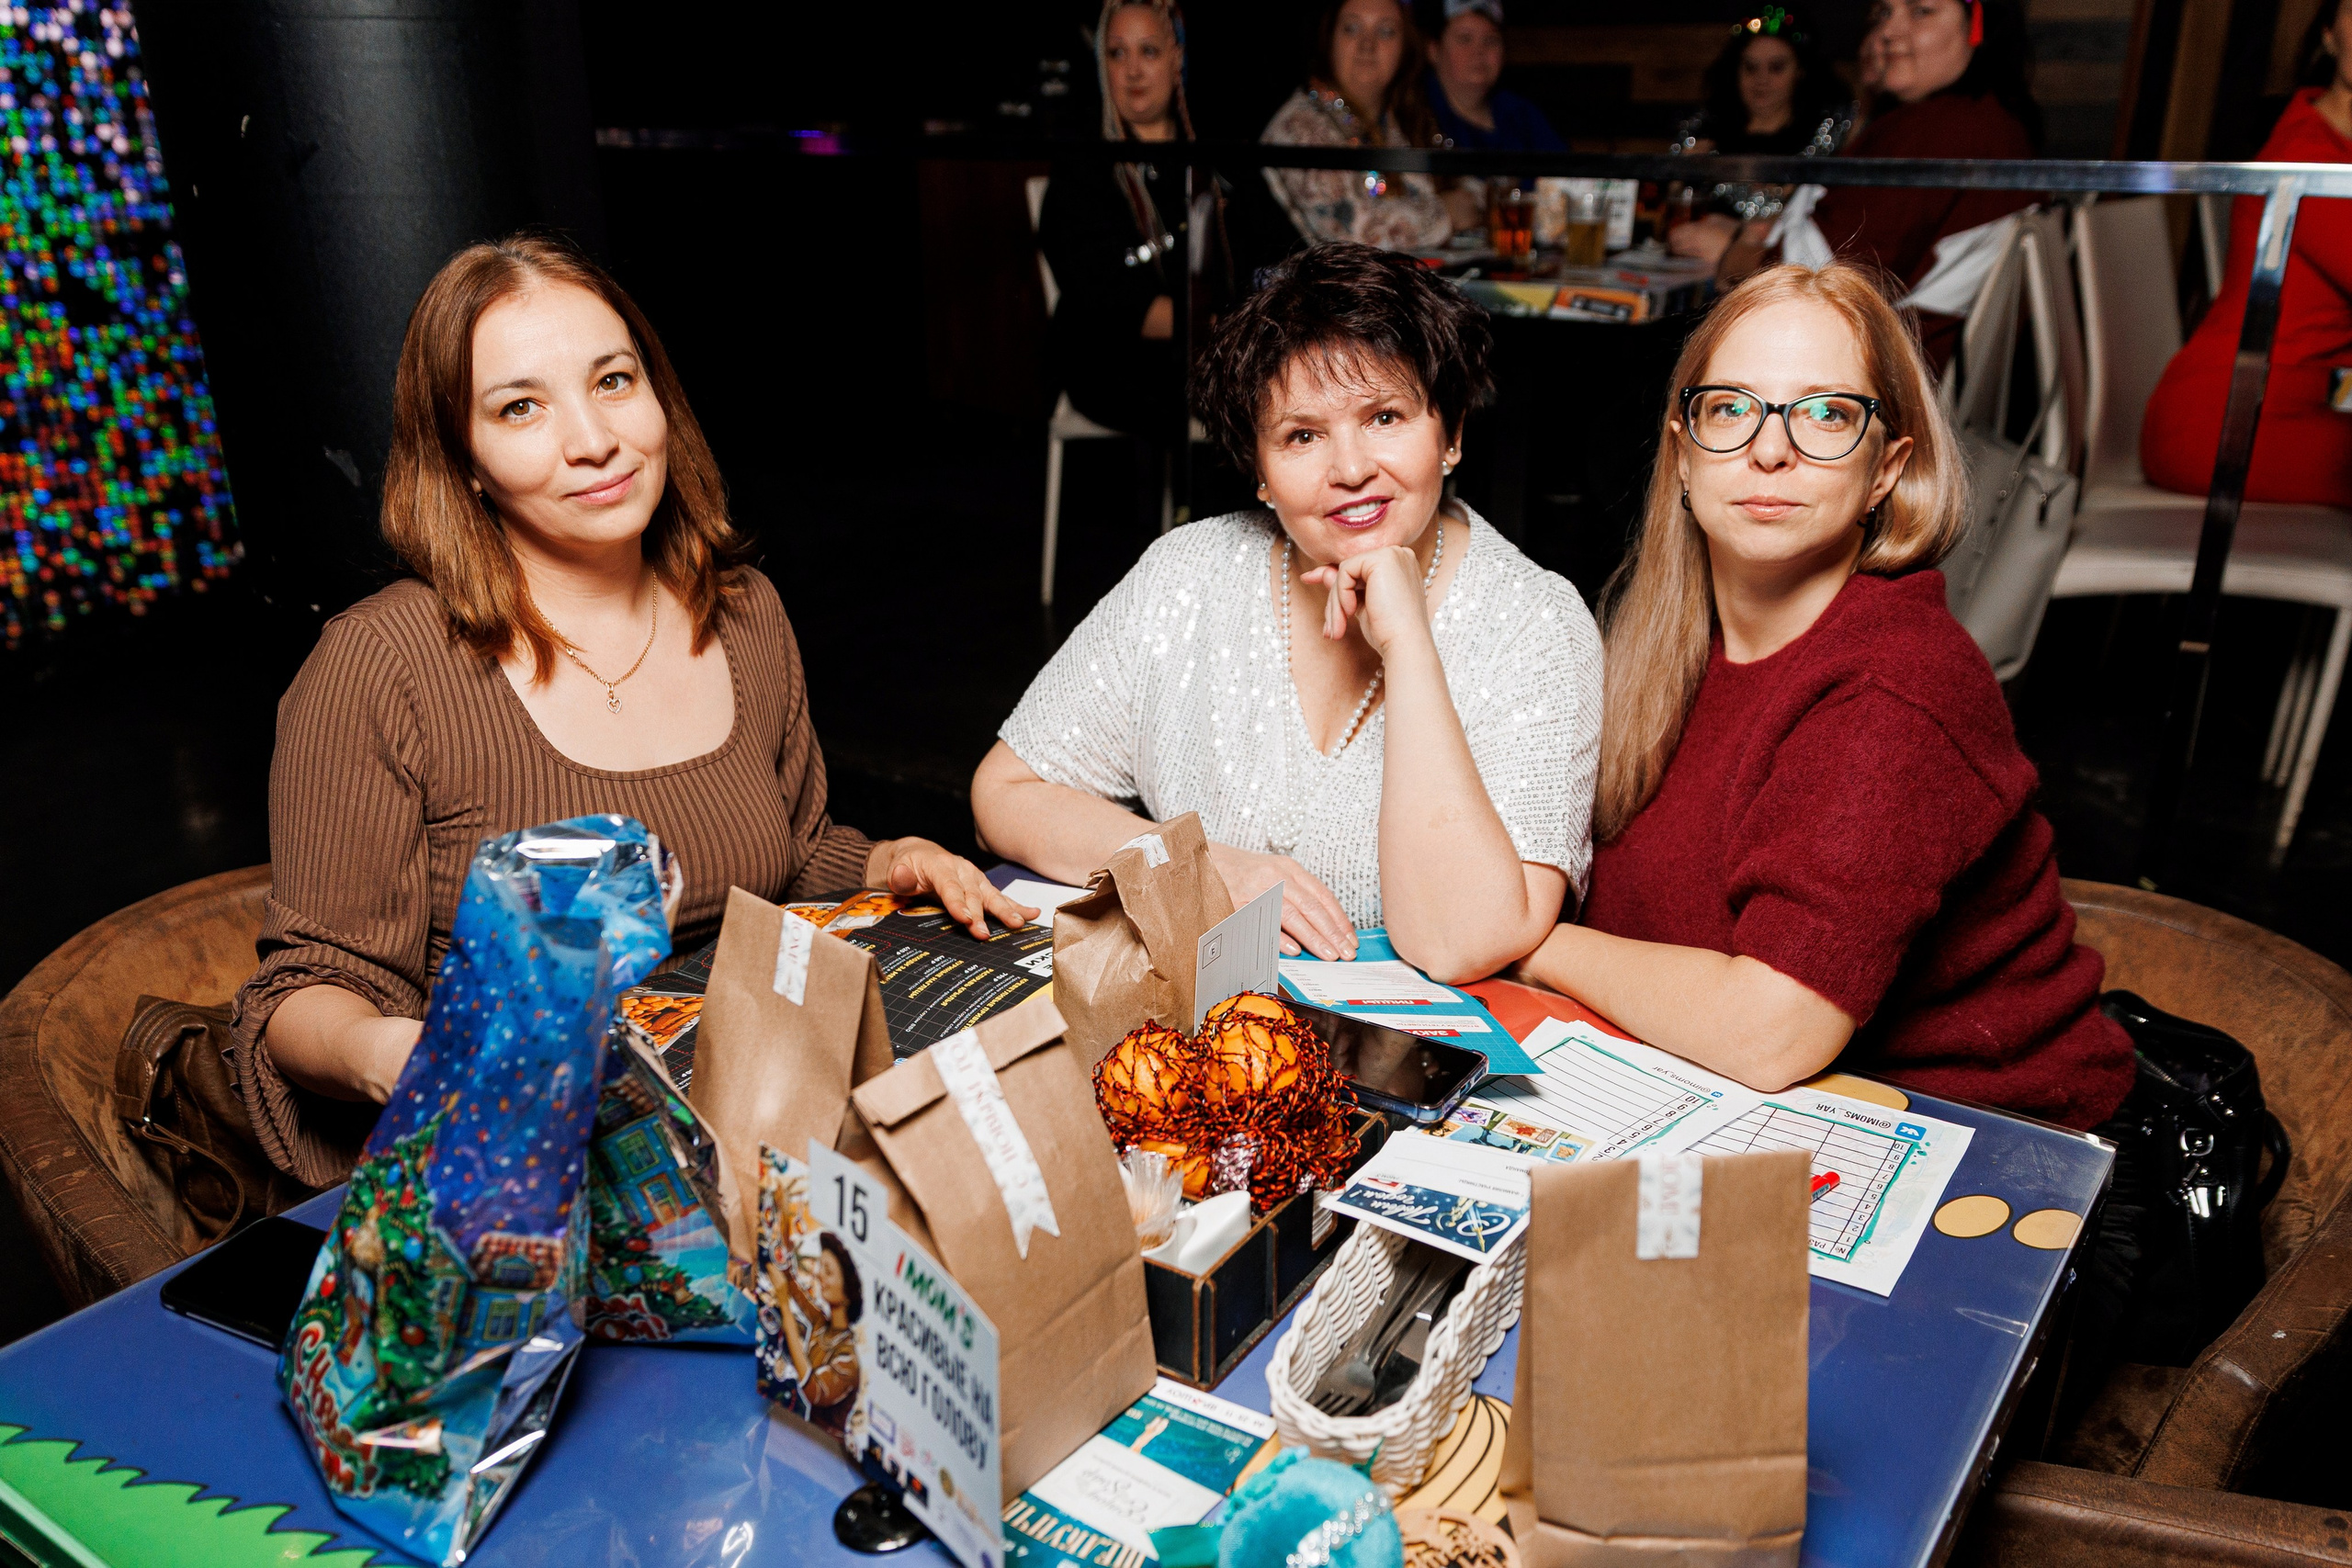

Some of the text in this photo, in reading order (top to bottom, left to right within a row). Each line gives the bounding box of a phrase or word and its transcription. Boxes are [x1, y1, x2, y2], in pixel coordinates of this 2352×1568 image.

[934, 960, 965, 978] КУРИНЫЕ
[964, 968, 994, 987] РАСПРАВЬ
[908, 976, 937, 999] НАГЛЕЦЫ
[940, 987, 967, 1007] КРЫЛЬЯ
[987, 977, 1029, 1010] КРЕВЕТЛИВЫЕ
[1651, 1066, 1712, 1093] @imoms_yar
[1685, 1095, 1701, 1104] 10
[1665, 1110, 1677, 1118] 8
[1629, 1131, 1641, 1139] 5
[1641, 1123, 1653, 1132] 6
[1603, 1145, 1615, 1154] 3
[1505, 1166, 1531, 1176] ОМАНДА
[834, 1174, 869, 1243] 15
[1370, 1200, 1439, 1224] Новым
[874, 1278, 995, 1437] КРАСИВЫЕ НА
[876, 1331, 989, 1472] ВСЮ ГОЛОВУ
